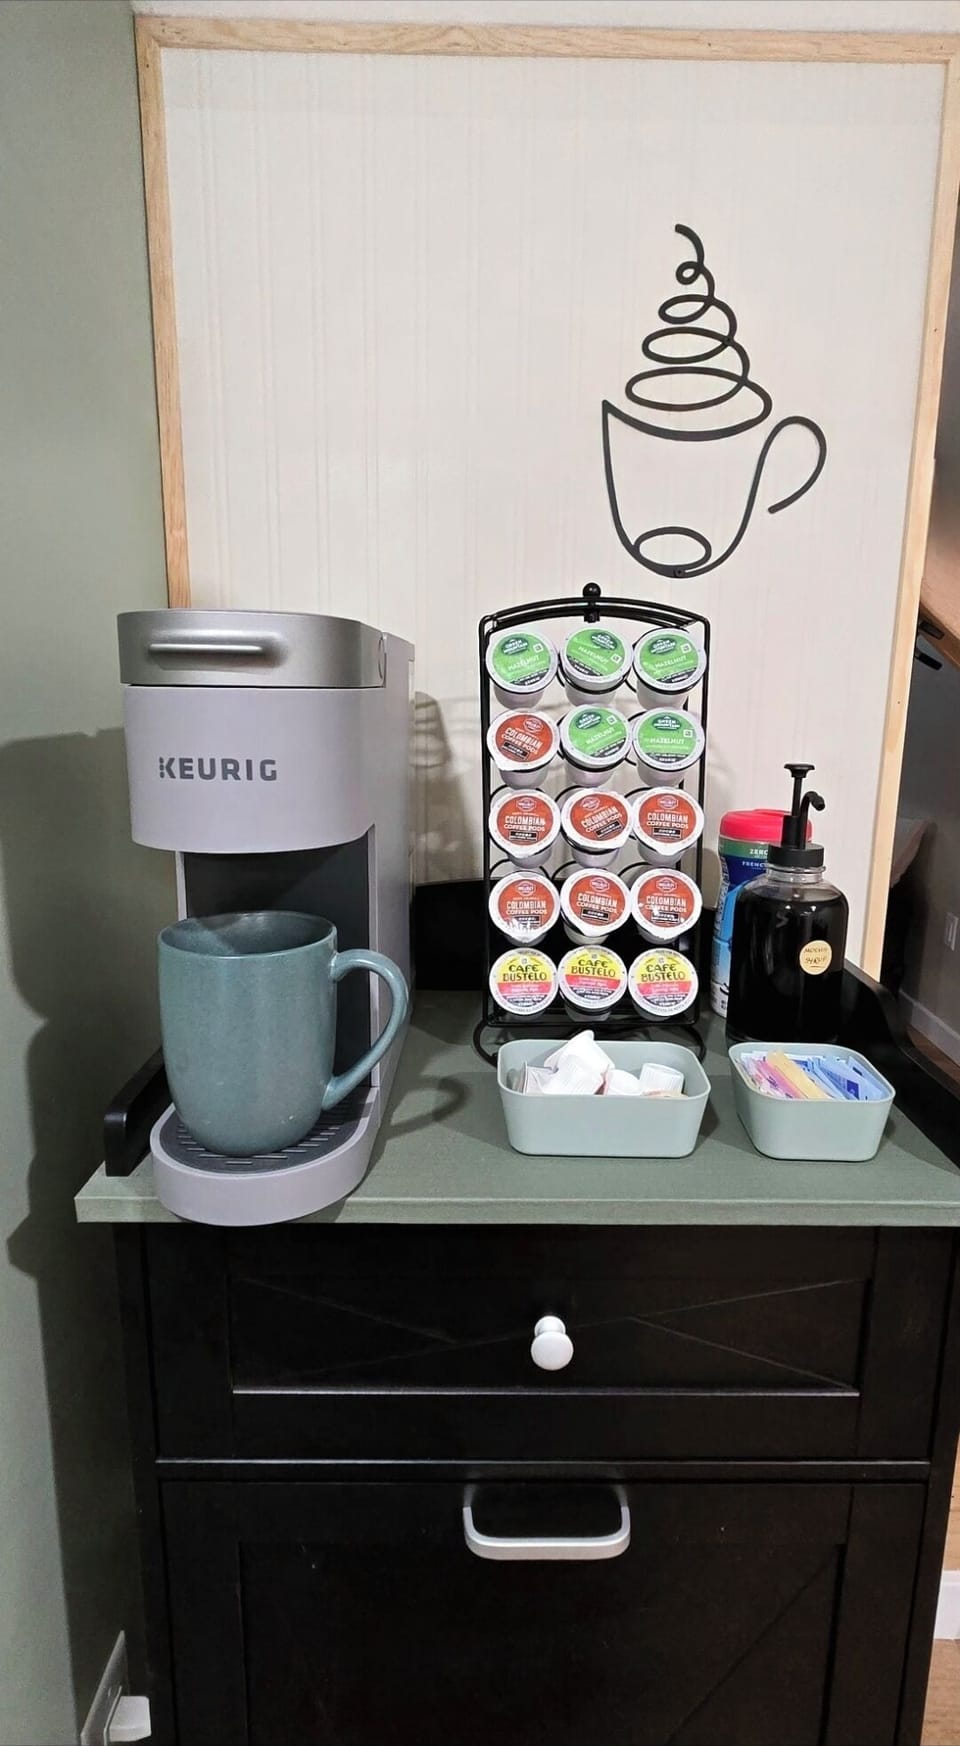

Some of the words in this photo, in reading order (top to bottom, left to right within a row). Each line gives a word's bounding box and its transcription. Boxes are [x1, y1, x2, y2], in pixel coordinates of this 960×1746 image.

[501, 733, 522, 746] COFFEE
[505, 727, 543, 750] COLOMBIAN
[159, 756, 277, 781] KEURIG
[505, 815, 546, 826] COLOMBIAN
[581, 806, 619, 828] COLOMBIAN
[647, 812, 689, 823] COLOMBIAN
[585, 820, 607, 833] COFFEE
[506, 900, 547, 909] COLOMBIAN
[576, 901, 600, 910] COFFEE
[577, 893, 618, 908] COLOMBIAN
[646, 895, 687, 907] COLOMBIAN
[502, 972, 548, 982] BUSTELO
[571, 966, 616, 978] BUSTELO
[641, 971, 686, 982] BUSTELO
